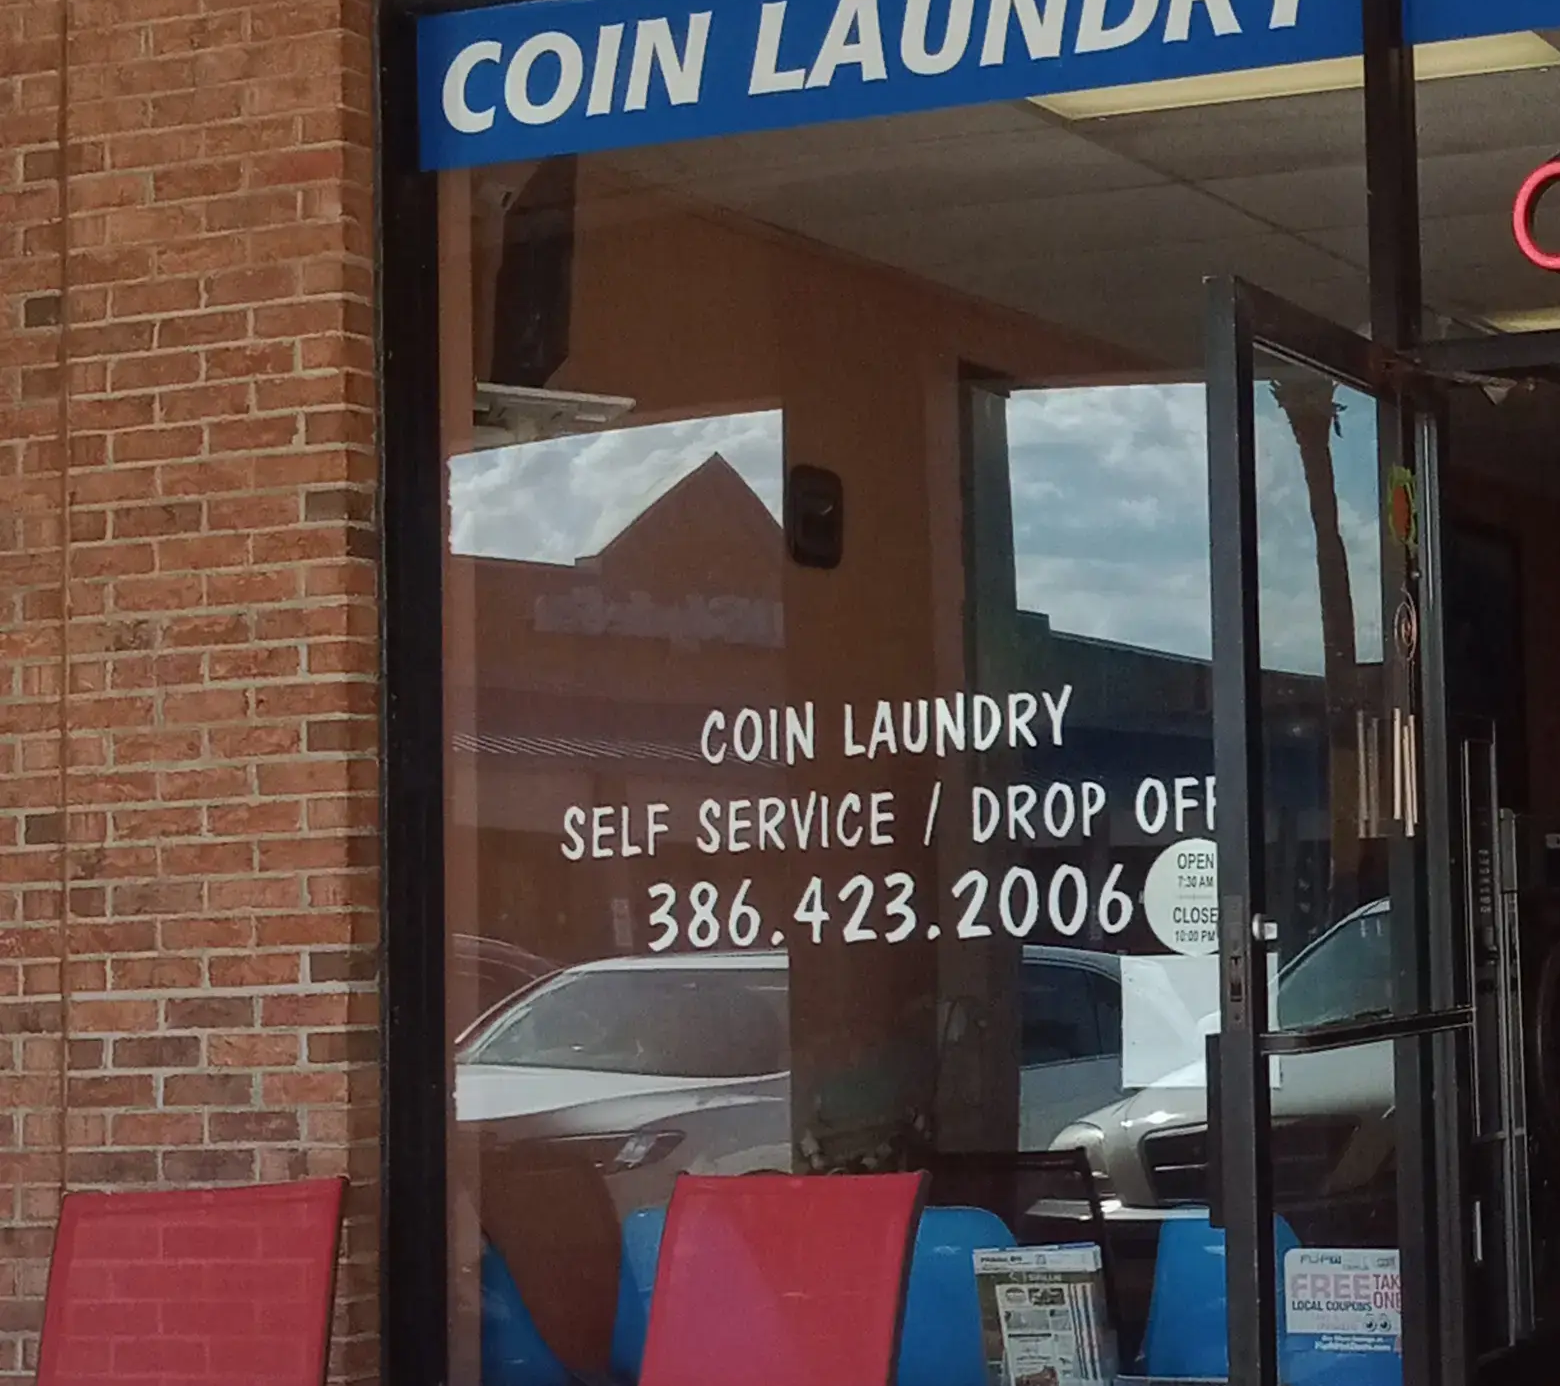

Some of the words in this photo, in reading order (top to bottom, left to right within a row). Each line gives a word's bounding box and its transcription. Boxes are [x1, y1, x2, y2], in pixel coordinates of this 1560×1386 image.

[441, 11, 713, 134] COIN
[701, 701, 815, 766] COIN
[844, 684, 1073, 759] LAUNDRY
[561, 803, 670, 862] SELF
[696, 789, 895, 855] SERVICE
[971, 779, 1106, 845] DROP
[1177, 853, 1214, 869] OPEN
[1178, 875, 1197, 888] 7:30
[1199, 875, 1214, 887] AM
[647, 863, 1134, 953] 386.423.2006
[1172, 906, 1219, 924] CLOSE
[1201, 930, 1216, 942] PM
[1291, 1274, 1371, 1300] FREE
[1372, 1274, 1401, 1290] TAK
[1292, 1300, 1323, 1311] LOCAL
[1326, 1301, 1373, 1312] COUPONS
